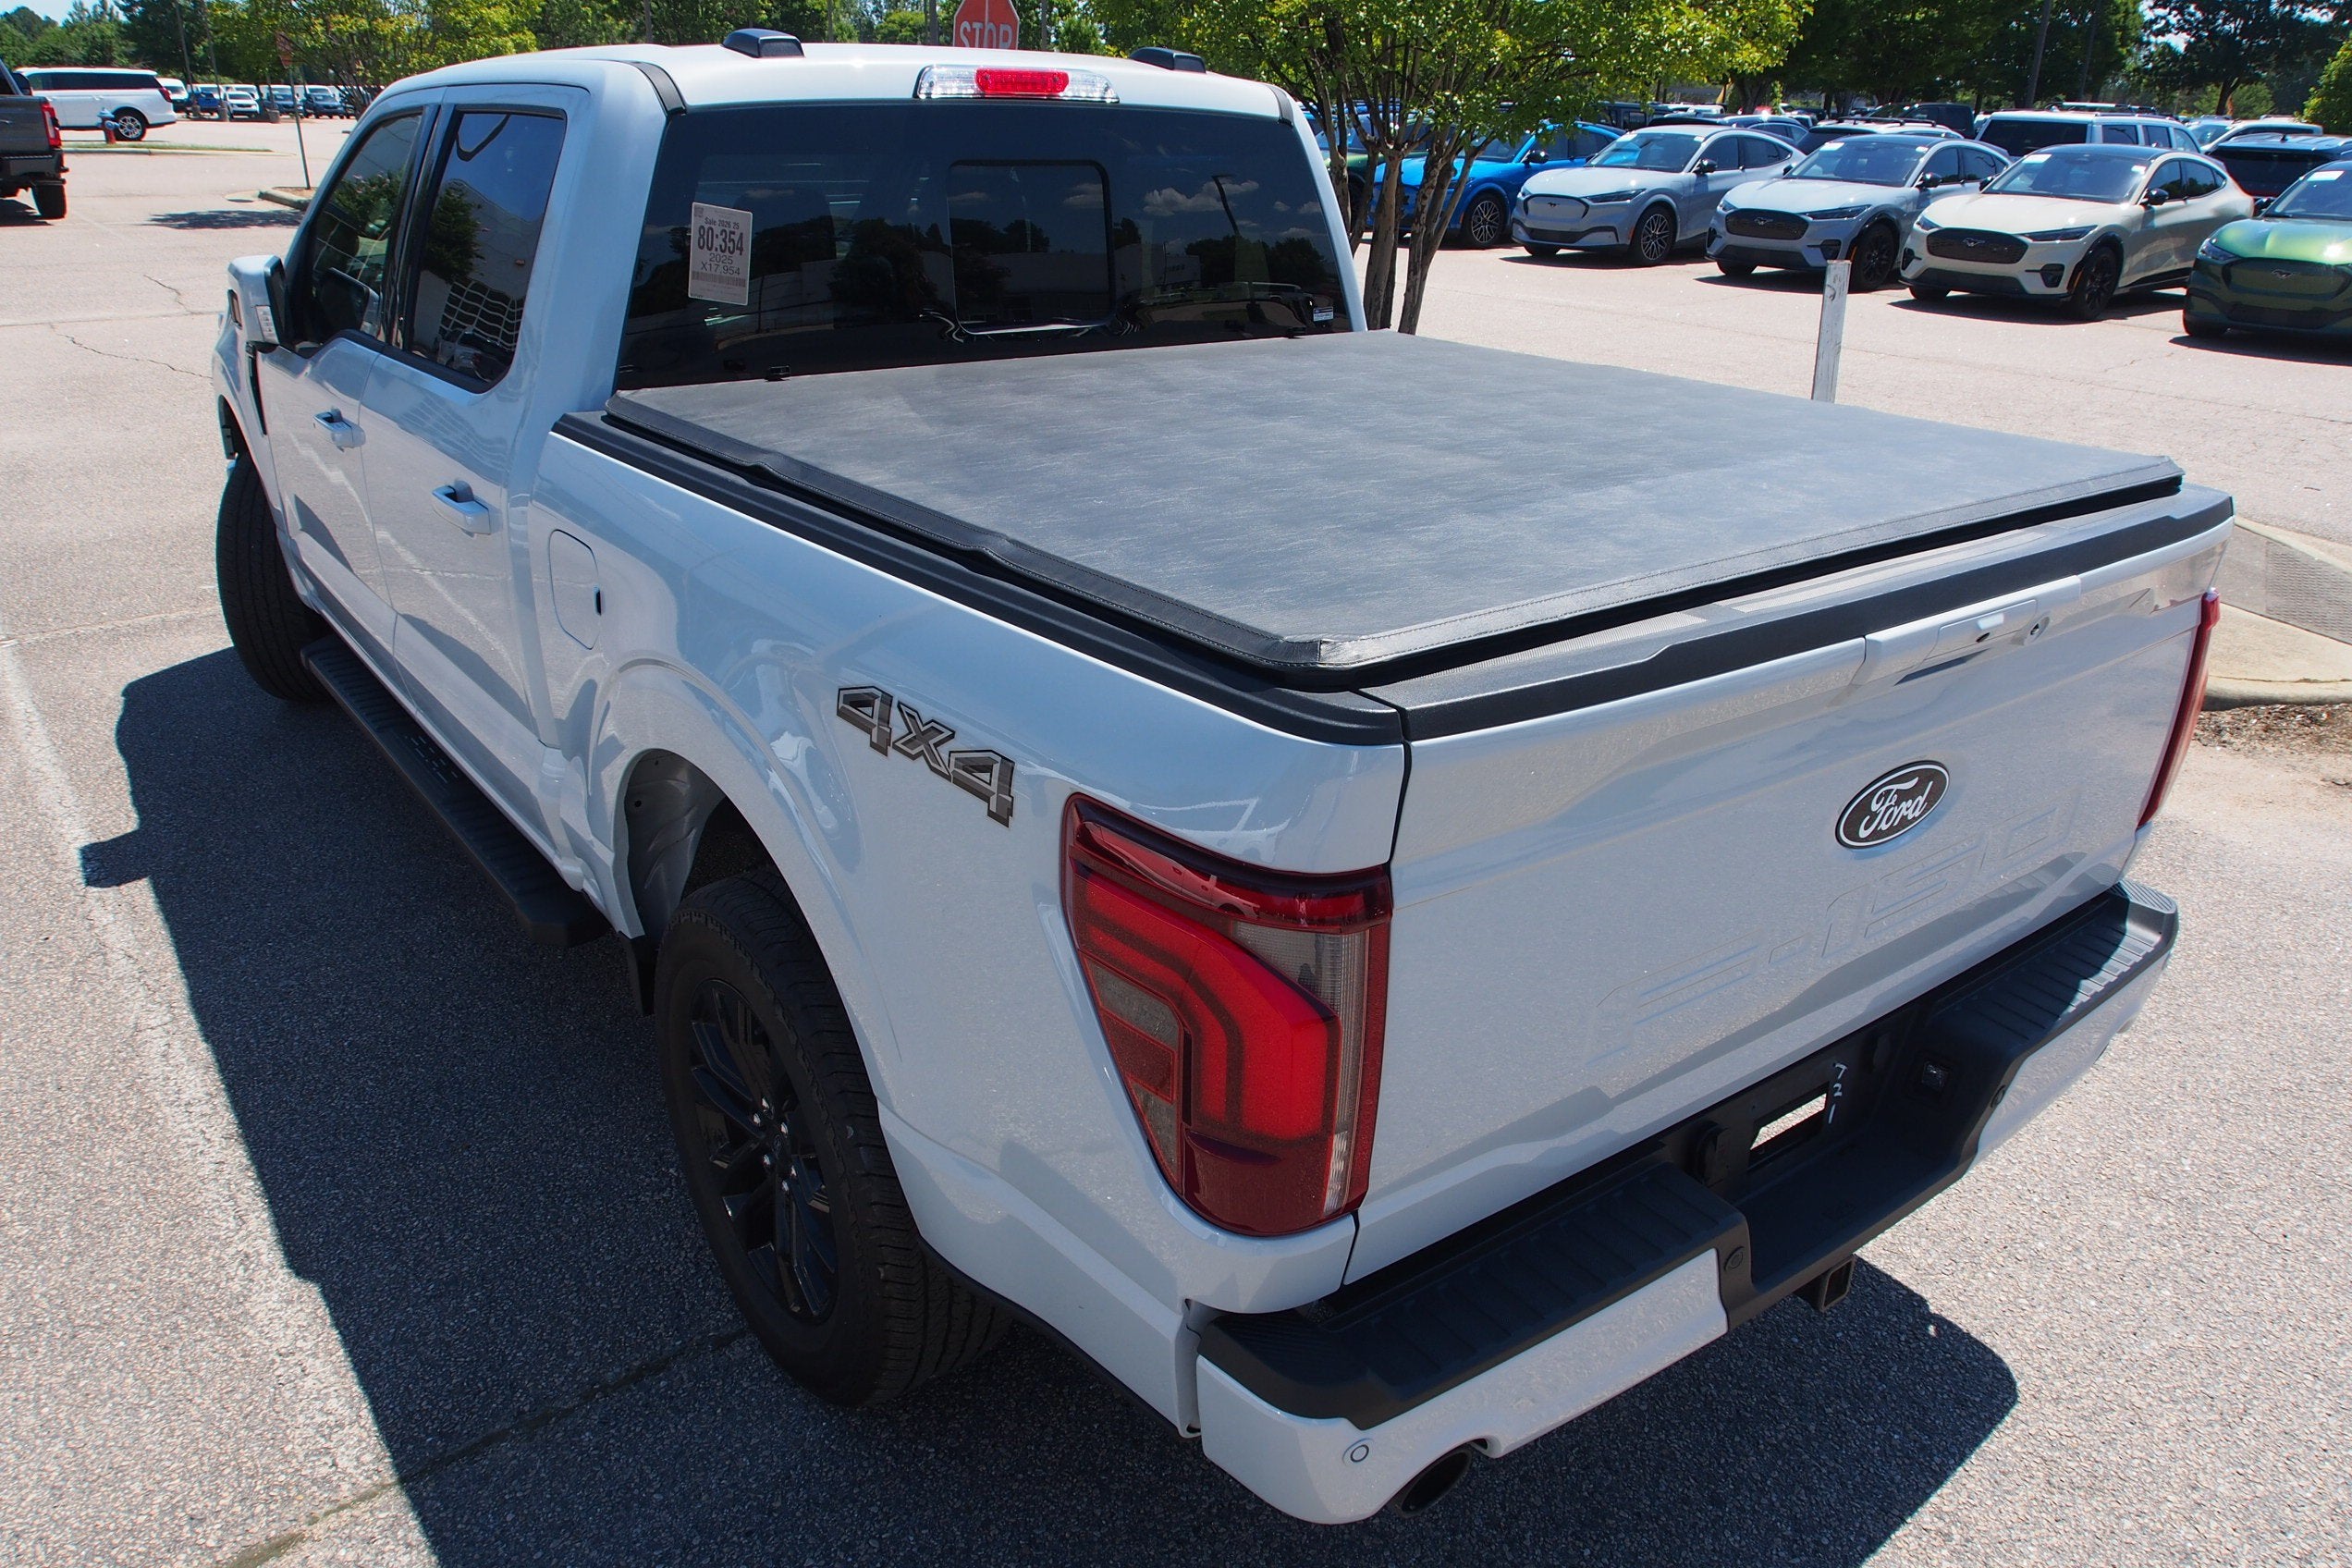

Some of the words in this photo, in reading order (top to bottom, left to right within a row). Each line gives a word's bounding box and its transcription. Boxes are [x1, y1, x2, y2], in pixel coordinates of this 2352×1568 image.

[960, 20, 1013, 49] STOP
[704, 216, 717, 227] Sale
[697, 225, 744, 256] 80:354
[701, 261, 741, 276] X17.954
[709, 252, 733, 265] 2025
[1858, 776, 1934, 839] Ford
